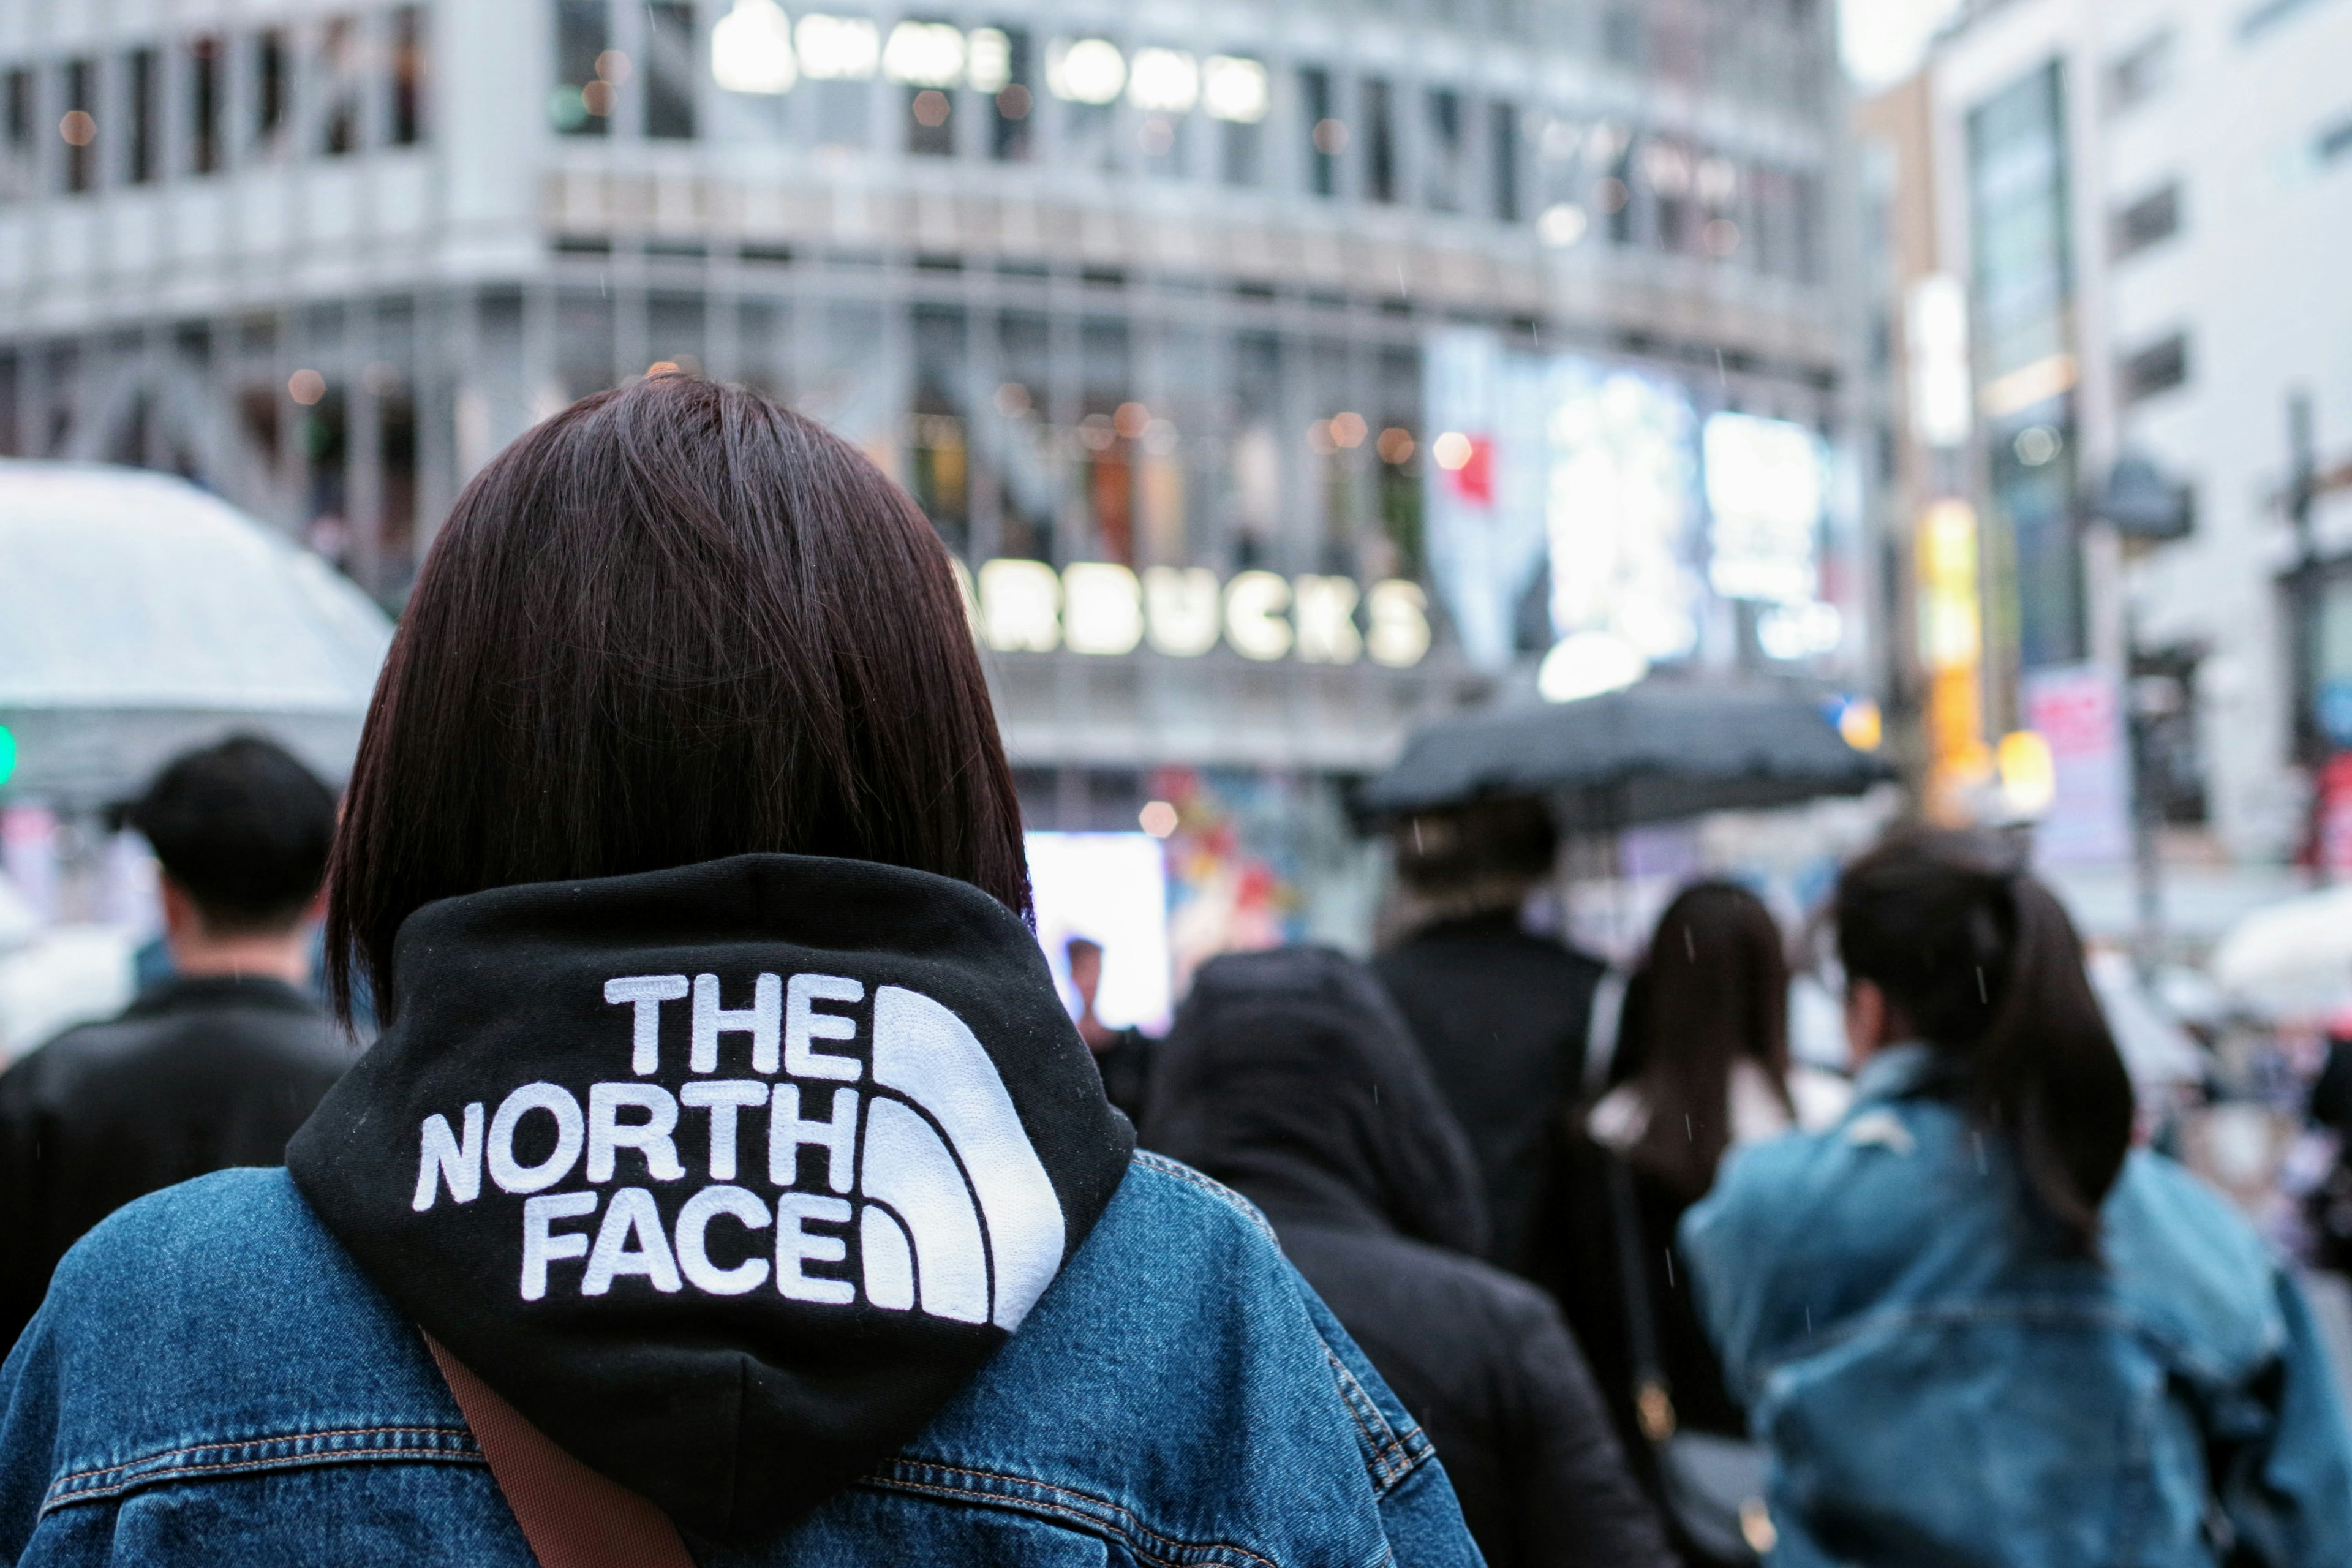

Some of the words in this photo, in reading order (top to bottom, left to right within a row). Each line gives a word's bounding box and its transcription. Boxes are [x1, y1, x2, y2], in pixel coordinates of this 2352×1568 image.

[953, 558, 1431, 668] RBUCKS
[604, 973, 865, 1082] THE
[412, 1079, 860, 1212] NORTH
[520, 1185, 856, 1305] FACE
